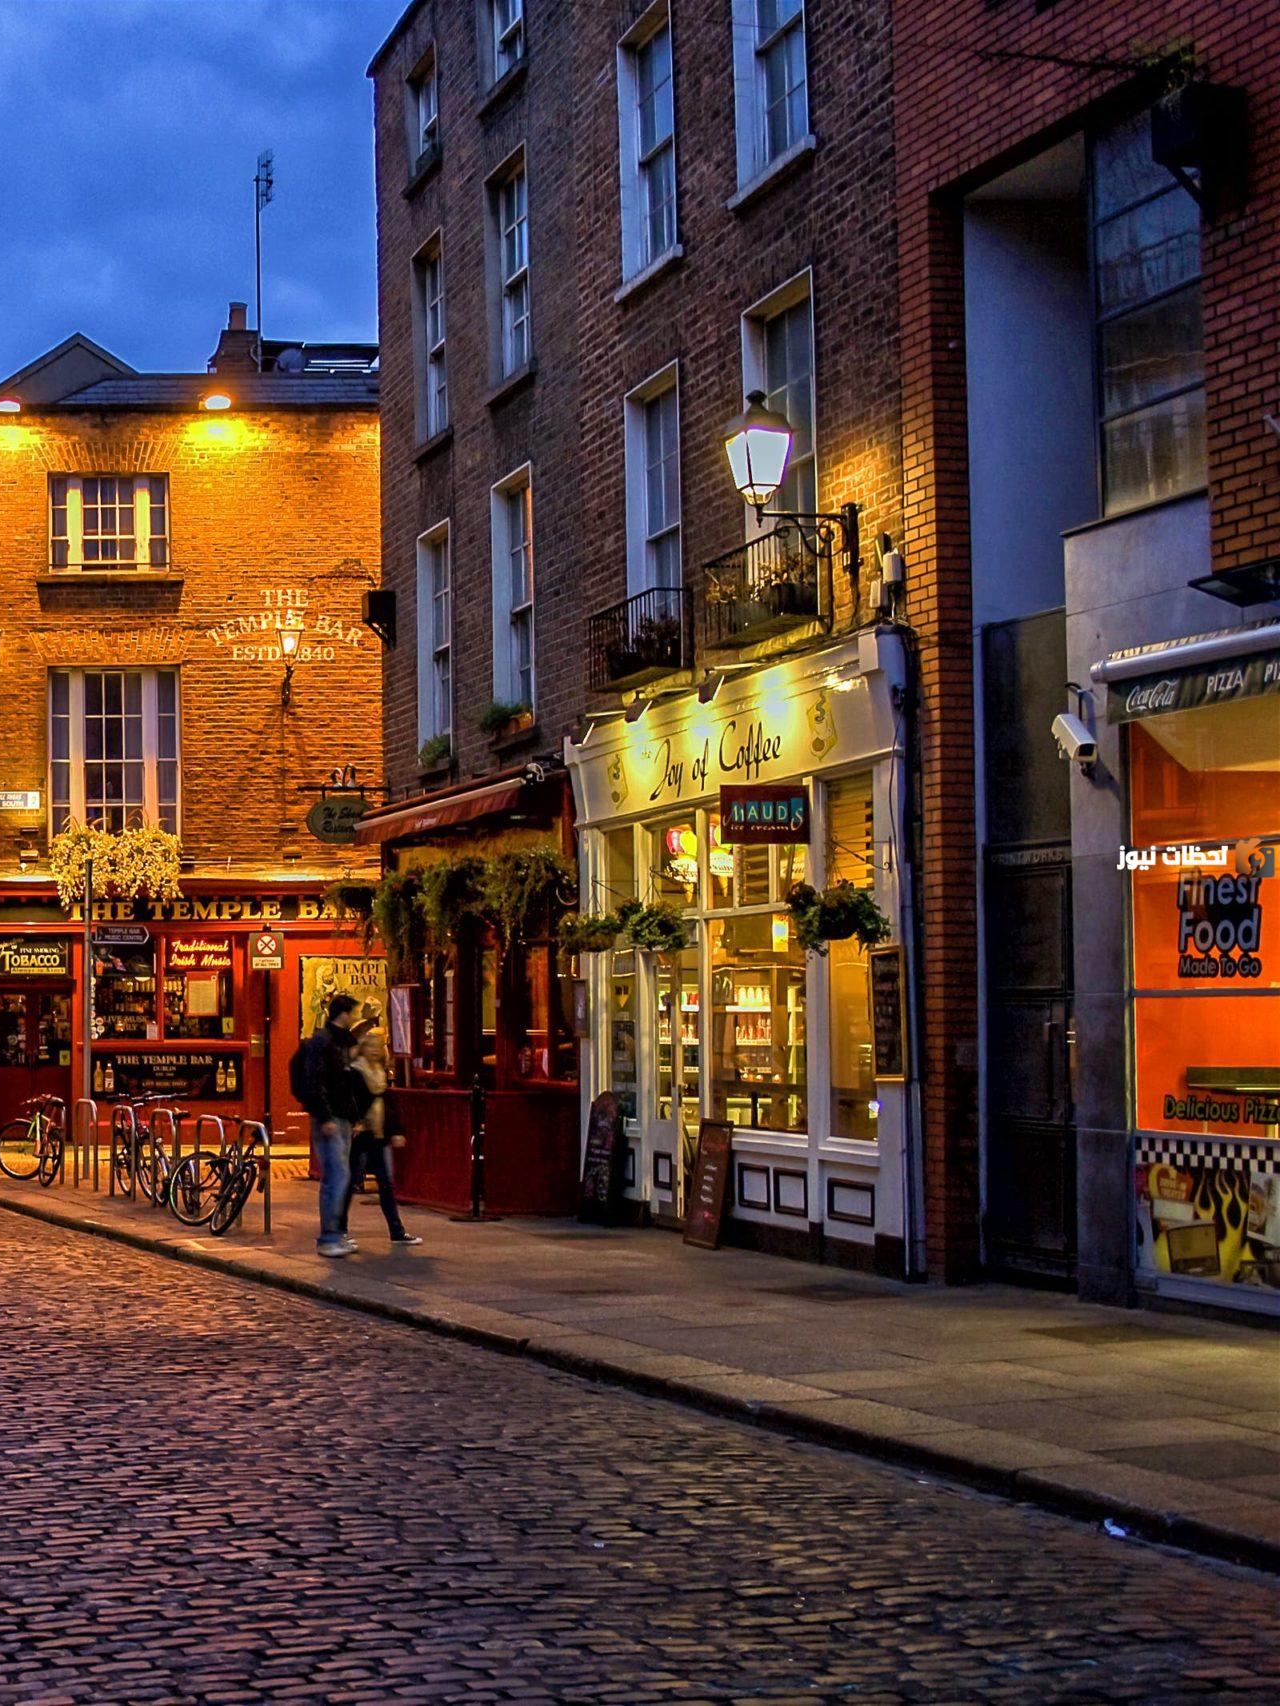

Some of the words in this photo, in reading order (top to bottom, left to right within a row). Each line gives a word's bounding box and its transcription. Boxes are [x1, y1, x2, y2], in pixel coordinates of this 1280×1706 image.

[260, 589, 309, 607] THE
[206, 609, 305, 647] TEMPLE
[314, 615, 363, 647] BAR
[1206, 669, 1244, 695] PIZZA
[649, 738, 683, 801] Joy
[692, 737, 709, 791] of
[720, 720, 781, 780] Coffee
[1179, 869, 1259, 906] Finest
[70, 901, 135, 921] THE
[147, 901, 282, 921] TEMPLE
[297, 901, 362, 921] BAR
[1179, 908, 1259, 951] Food
[171, 940, 229, 952] Traditional
[0, 951, 60, 971] TOBACCO
[169, 953, 196, 966] Irish
[201, 953, 231, 967] Music
[1180, 957, 1217, 975] Made
[1221, 957, 1235, 975] To
[1238, 957, 1259, 975] Go
[350, 975, 378, 987] BAR
[115, 1055, 139, 1065] THE
[141, 1055, 187, 1065] TEMPLE
[190, 1055, 213, 1065] BAR
[1165, 1095, 1238, 1120] Delicious
